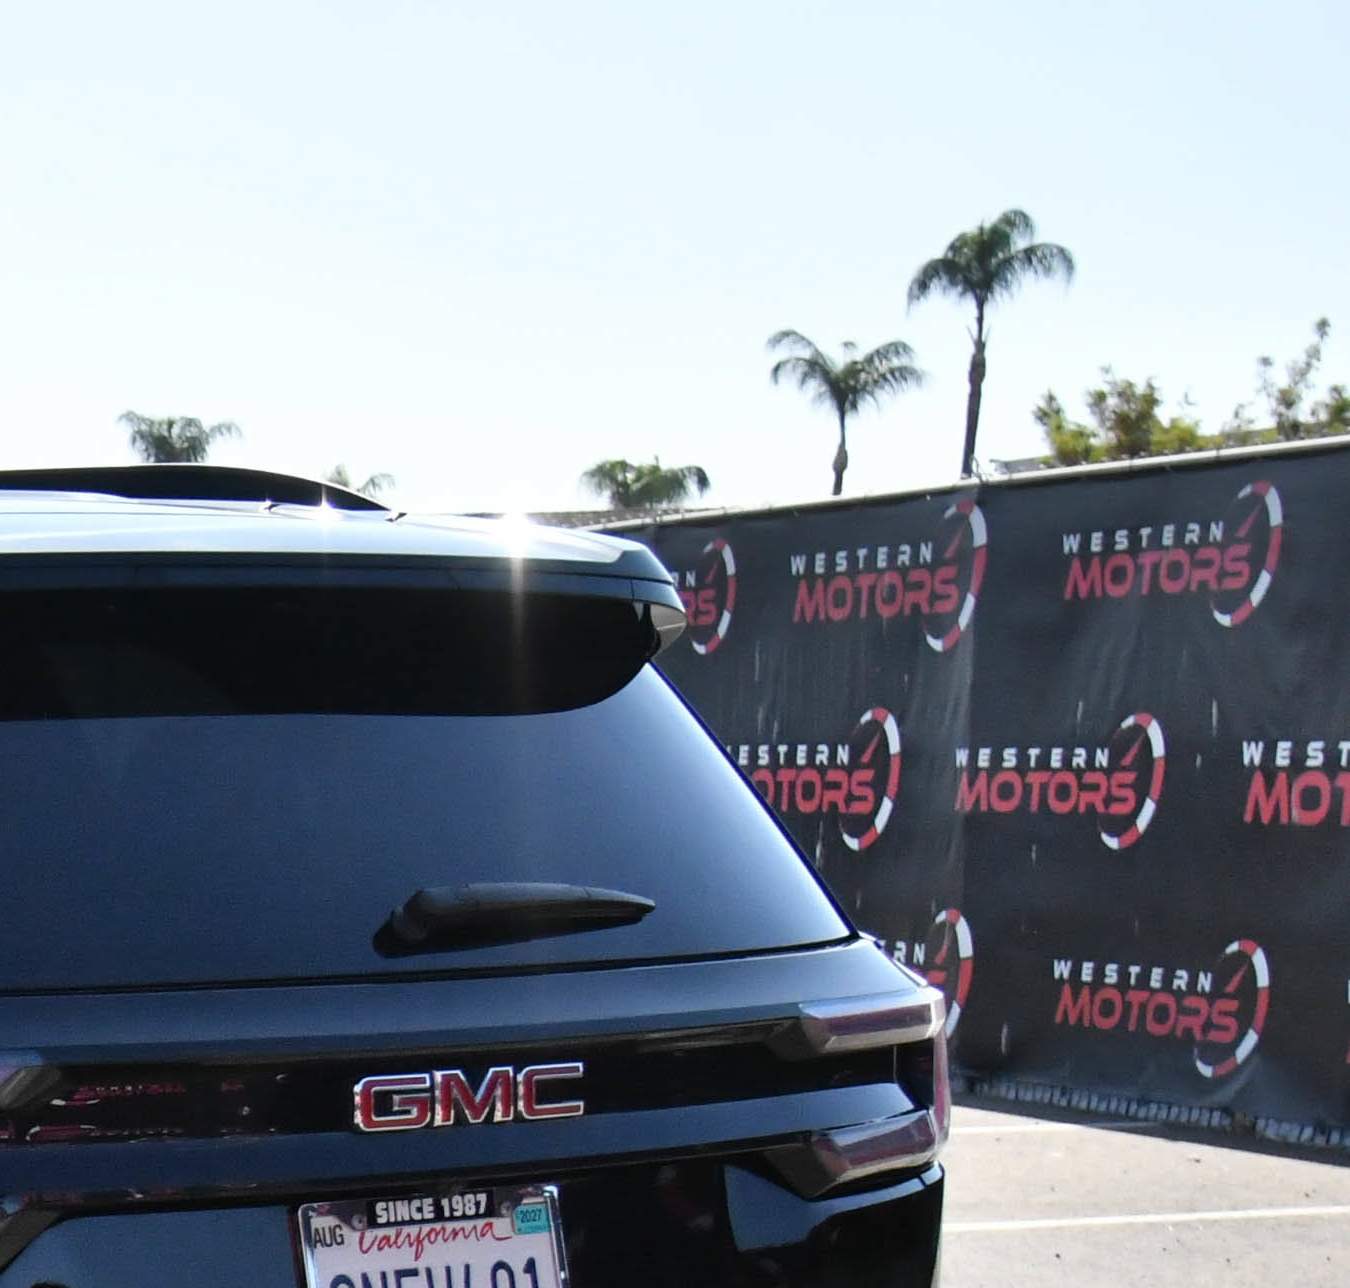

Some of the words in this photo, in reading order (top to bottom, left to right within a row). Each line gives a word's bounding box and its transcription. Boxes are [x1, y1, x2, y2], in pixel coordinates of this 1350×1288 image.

[1062, 520, 1225, 555] WESTERN
[790, 541, 933, 576] WESTERN
[1063, 543, 1252, 600] MOTORS
[792, 565, 960, 624] MOTORS
[728, 743, 850, 767] ESTERN
[955, 747, 1110, 769] WESTERN
[748, 768, 876, 814] OTORS
[954, 769, 1138, 815] MOTORS
[1053, 958, 1213, 994] WESTERN
[1054, 983, 1240, 1044] MOTORS
[353, 1061, 585, 1133] GMC
[375, 1197, 435, 1225] SINCE
[440, 1193, 488, 1218] 1987
[313, 1224, 345, 1250] AUG
[358, 1220, 512, 1262] California
